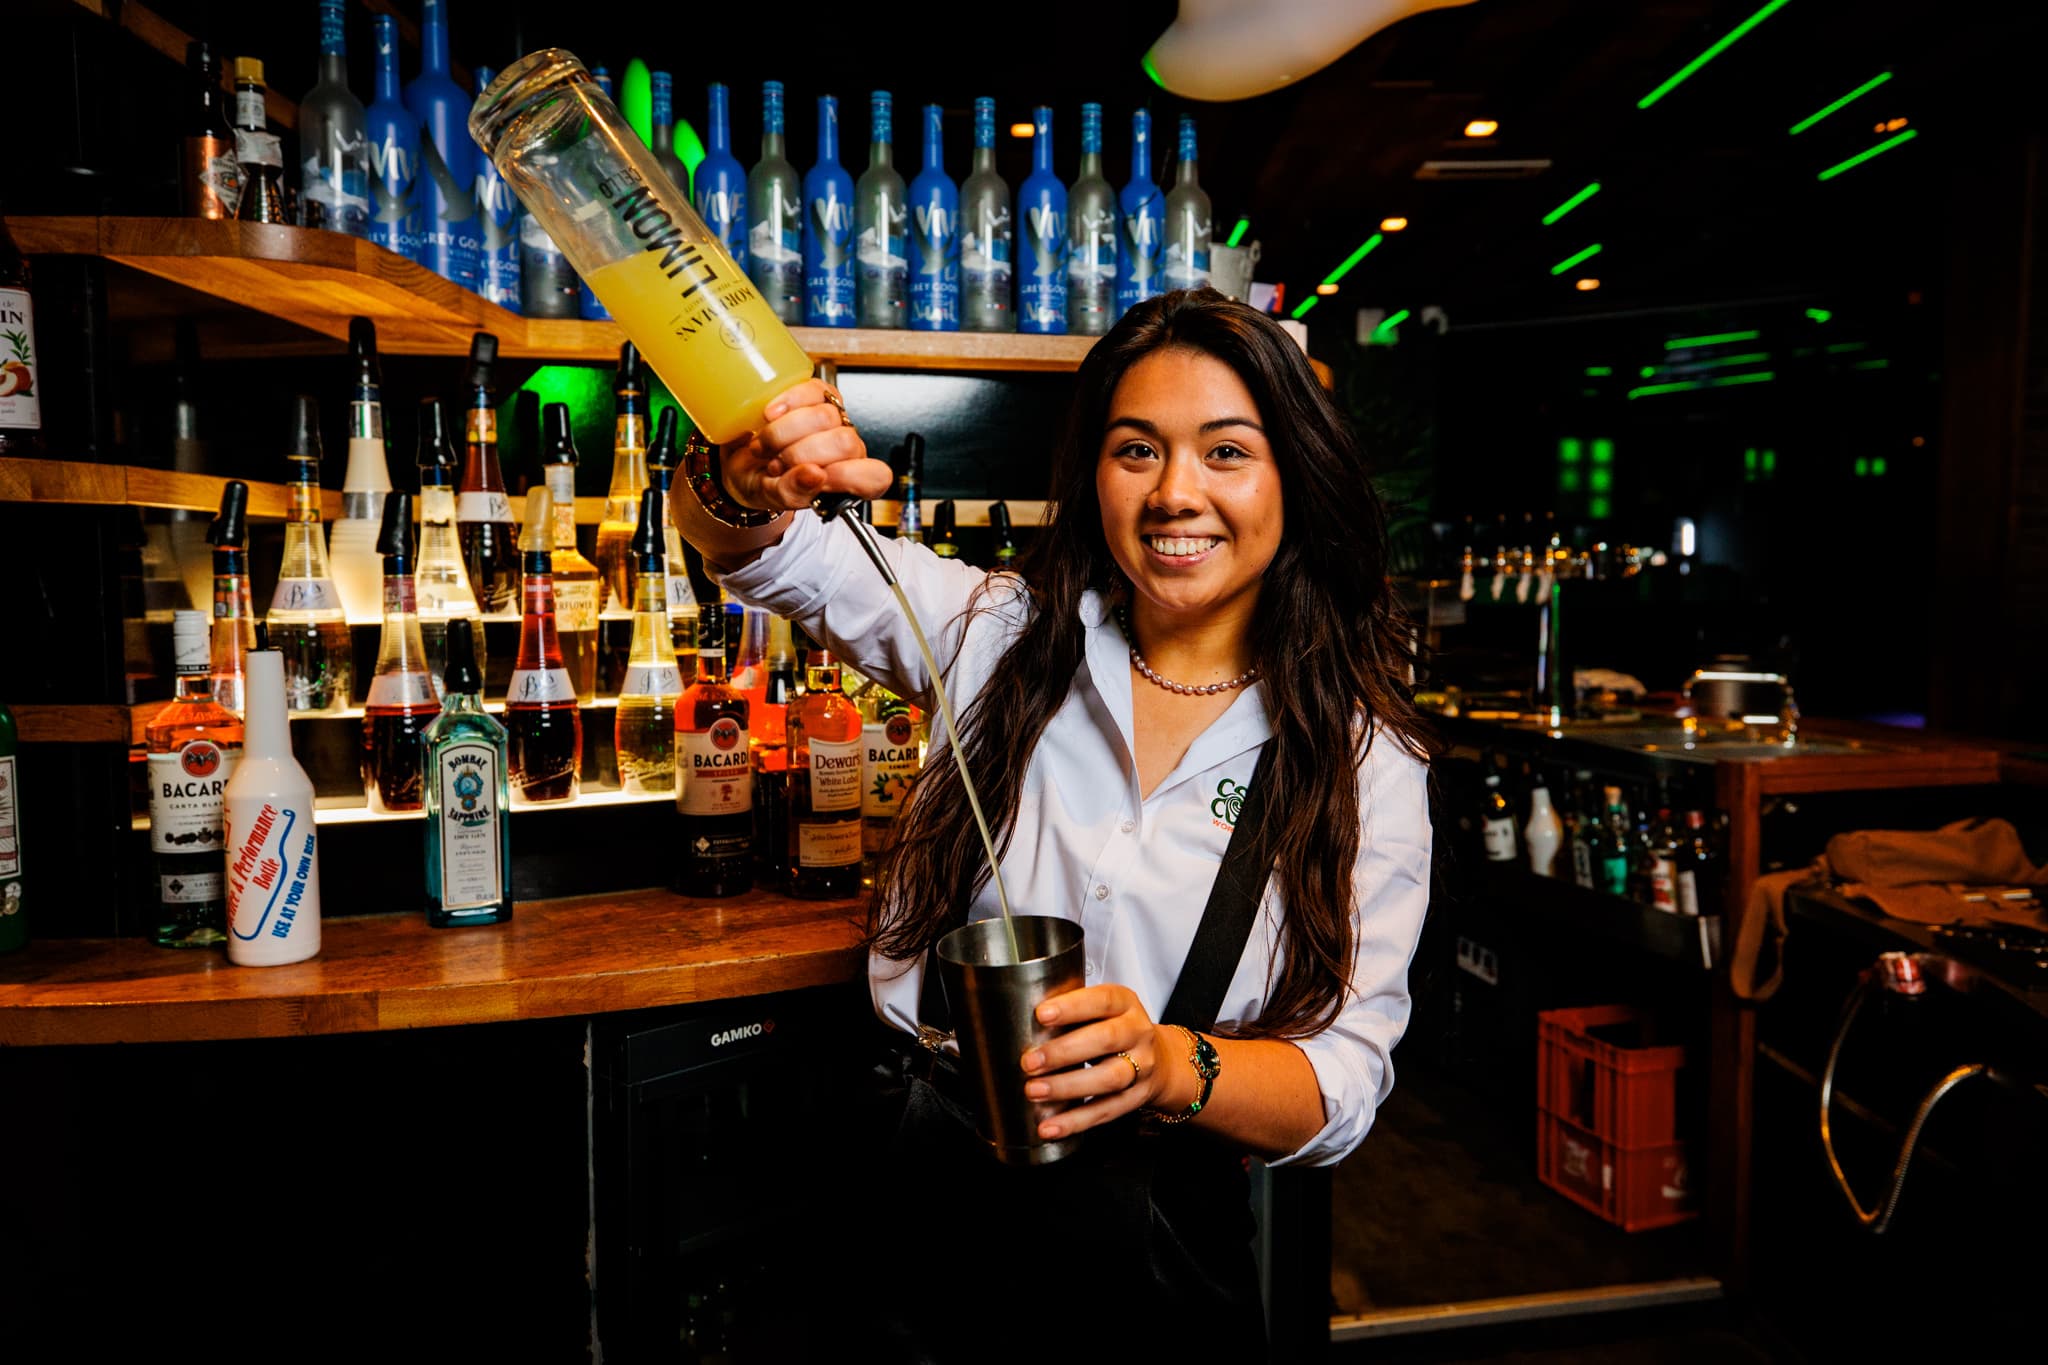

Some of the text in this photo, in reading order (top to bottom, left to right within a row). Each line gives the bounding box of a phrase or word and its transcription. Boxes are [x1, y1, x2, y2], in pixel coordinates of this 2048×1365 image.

[612, 186, 718, 299] LIMON
[448, 754, 488, 772] BOMBAY
[232, 804, 279, 881] Performance
[252, 858, 280, 891] Bottle
[272, 833, 315, 938] USE AT YOUR OWN RISK
[711, 1022, 763, 1048] GAMKO
